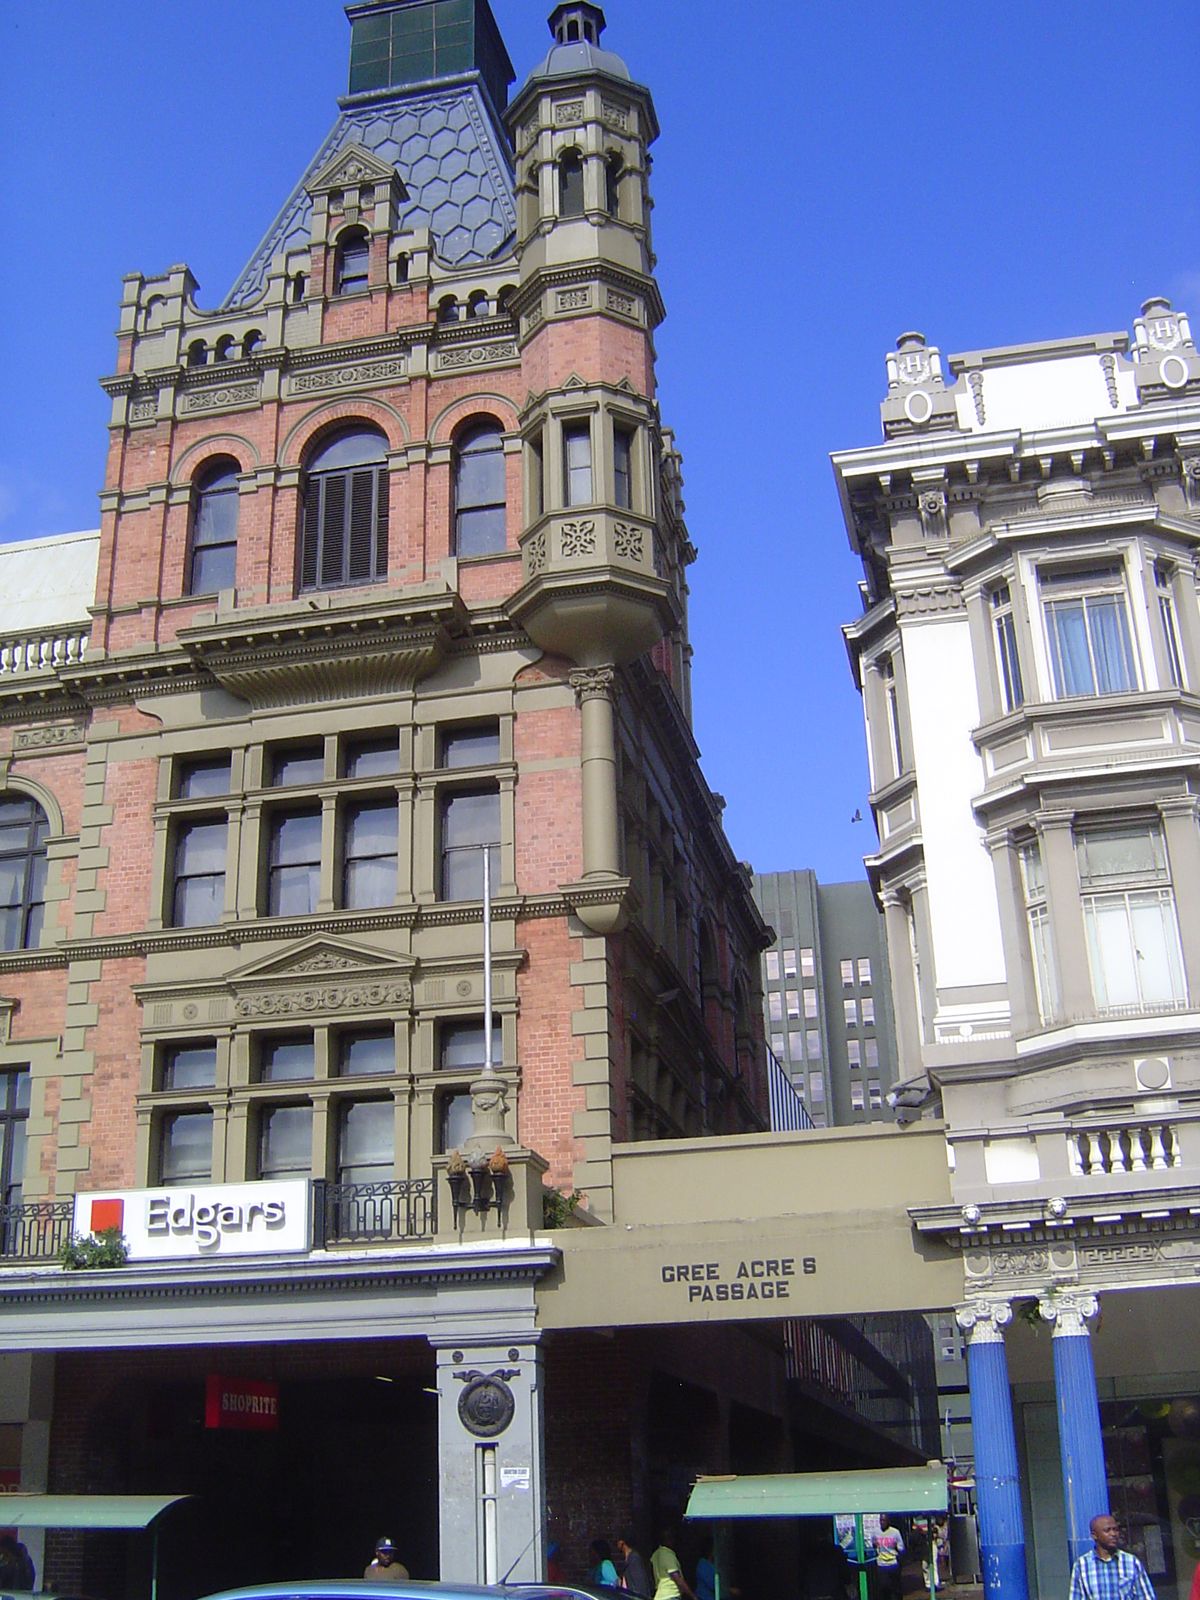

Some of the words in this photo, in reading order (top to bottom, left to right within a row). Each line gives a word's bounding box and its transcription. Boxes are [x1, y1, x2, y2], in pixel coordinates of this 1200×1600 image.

[146, 1193, 286, 1253] Edgars
[661, 1263, 720, 1283] GREE
[688, 1280, 790, 1302] PASSAGE
[222, 1392, 278, 1415] SHOPRITE
